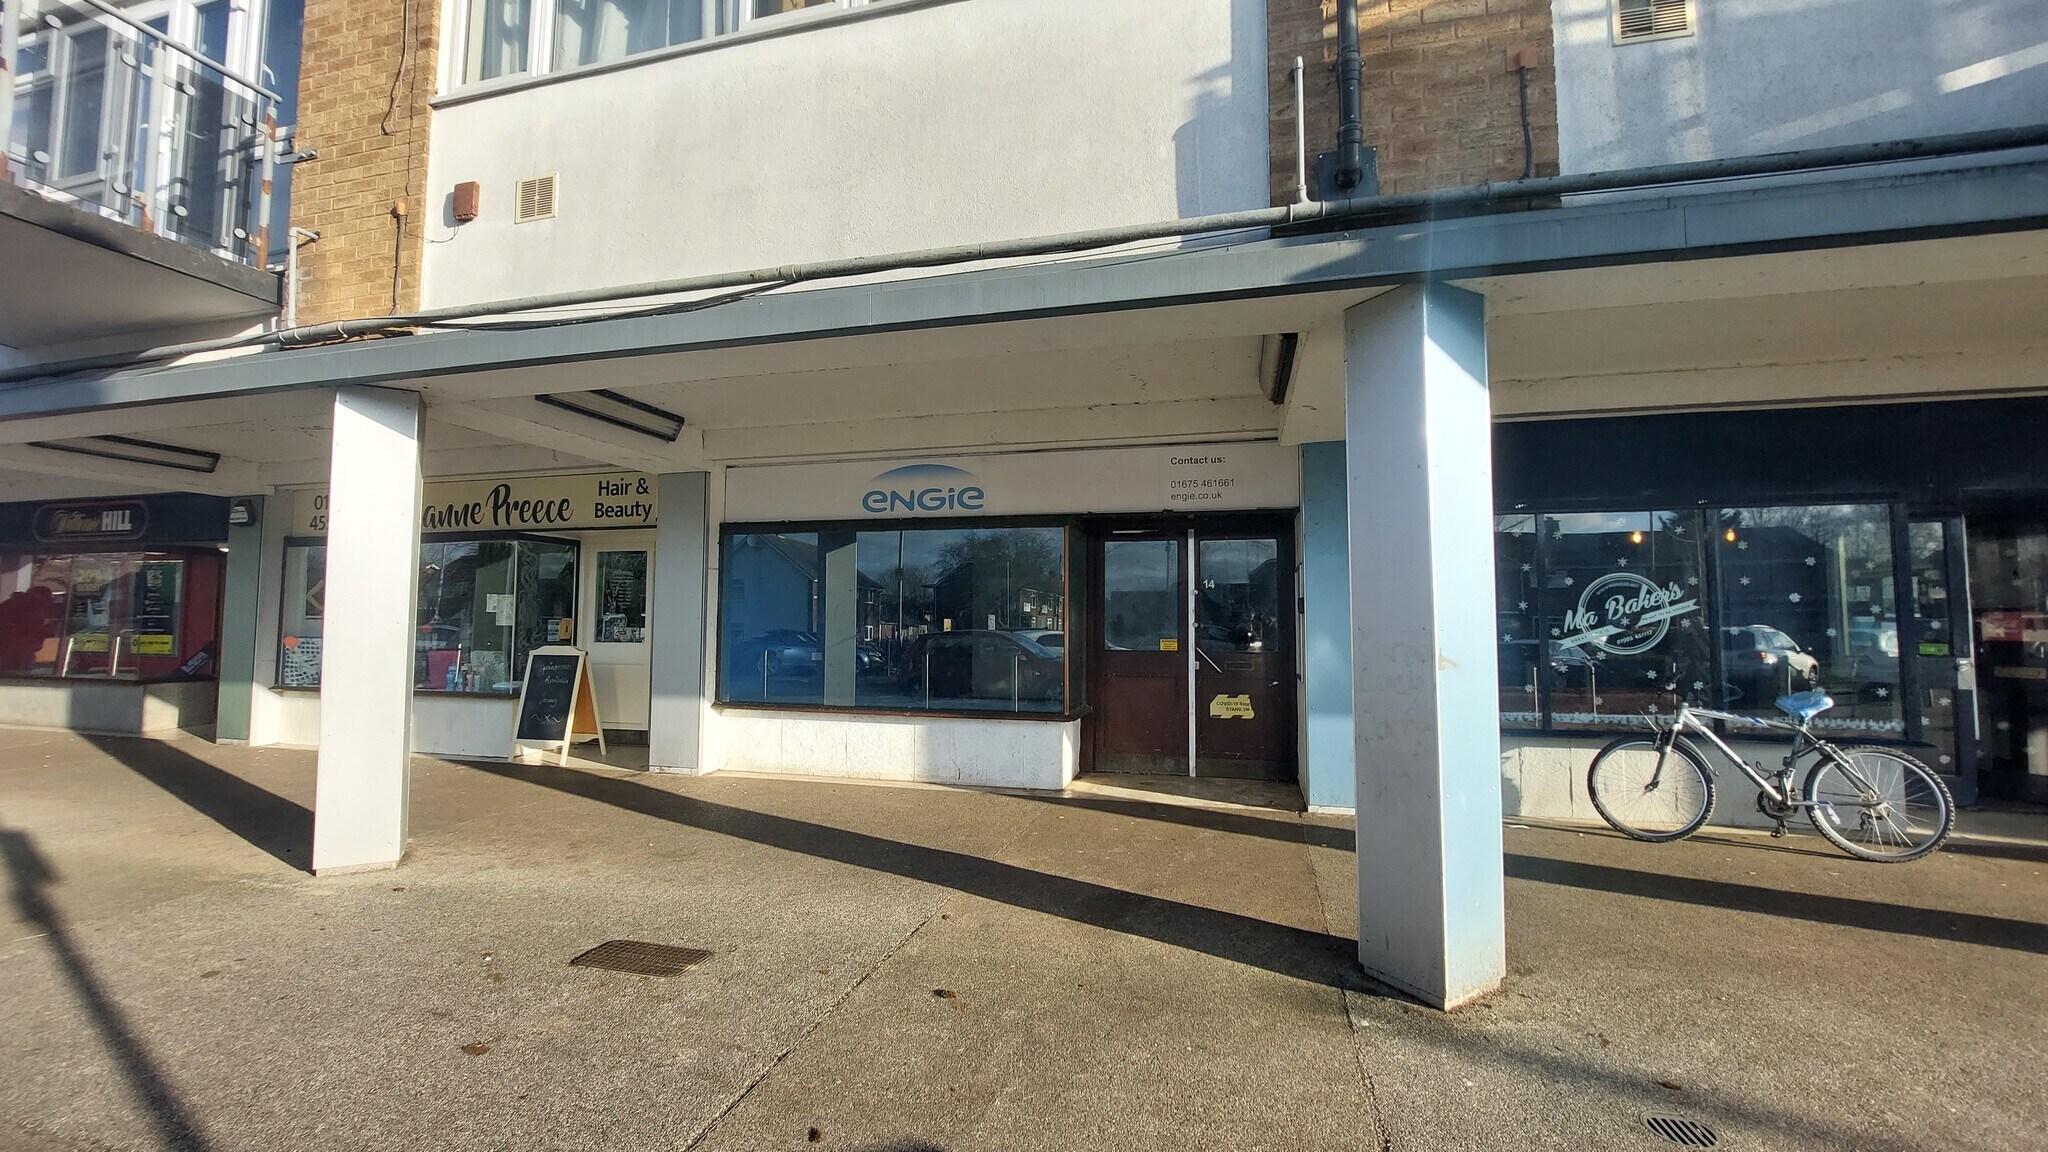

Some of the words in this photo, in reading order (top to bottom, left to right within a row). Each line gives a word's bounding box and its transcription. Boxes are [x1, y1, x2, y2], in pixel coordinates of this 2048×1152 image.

[1170, 456, 1208, 465] Contact
[1210, 456, 1226, 464] us:
[598, 477, 633, 497] Hair
[635, 477, 650, 495] &
[1170, 480, 1199, 489] 01675
[1200, 478, 1235, 488] 461661
[314, 494, 329, 510] 01
[1170, 490, 1223, 502] engie.co.uk
[422, 502, 486, 530] anne
[485, 483, 574, 528] Preece
[594, 501, 653, 523] Beauty
[101, 510, 132, 531] HILL
[309, 515, 328, 531] 45
[1203, 579, 1216, 589] 14
[1564, 606, 1598, 633] Ma
[1605, 581, 1684, 621] Baker's
